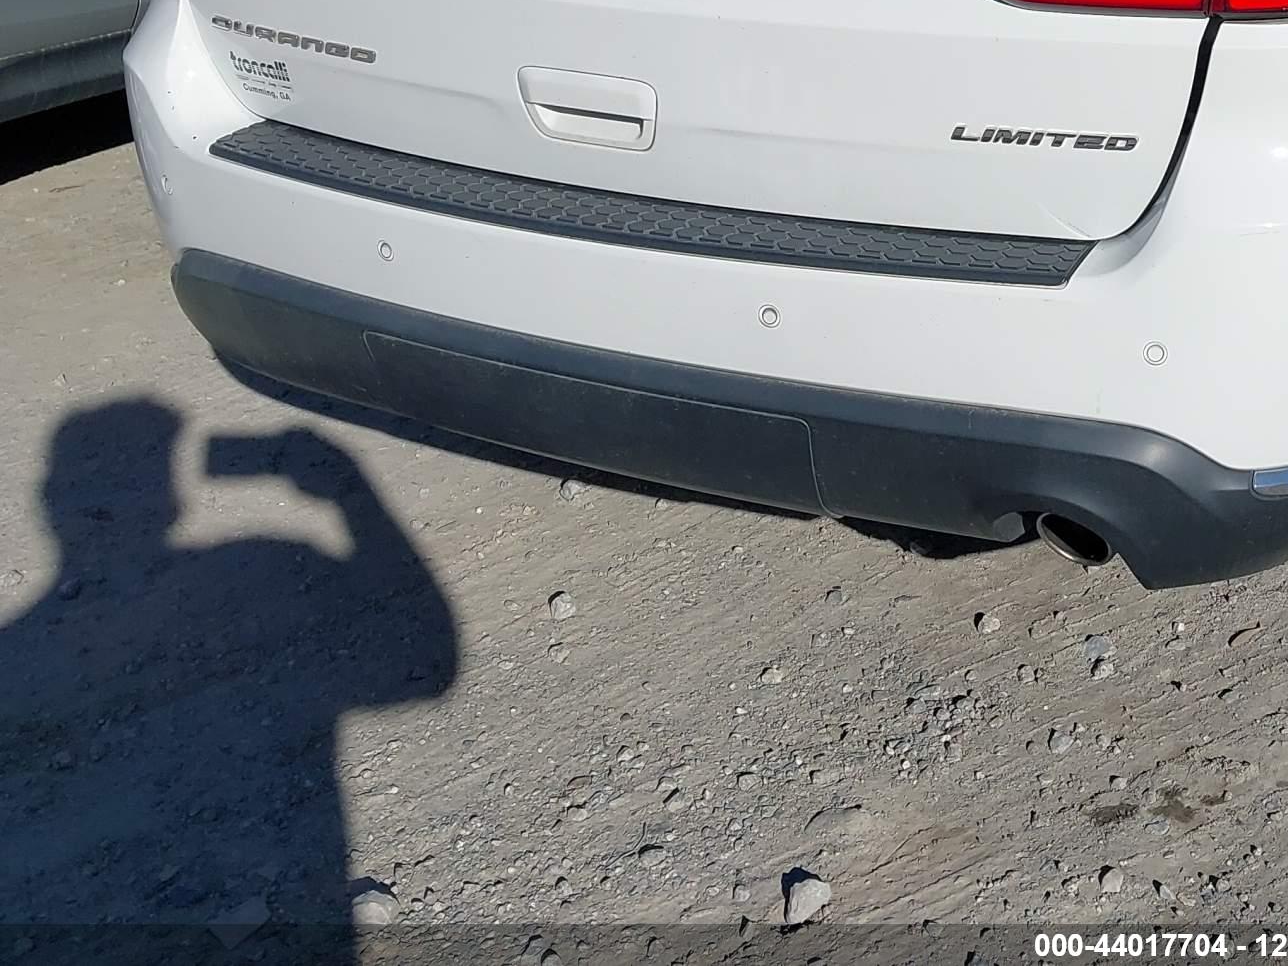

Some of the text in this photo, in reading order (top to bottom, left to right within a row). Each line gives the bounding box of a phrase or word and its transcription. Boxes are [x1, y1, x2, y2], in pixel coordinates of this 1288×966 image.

[211, 14, 377, 64] DURANGO
[279, 91, 292, 101] GA
[950, 126, 1138, 151] LIMITED
